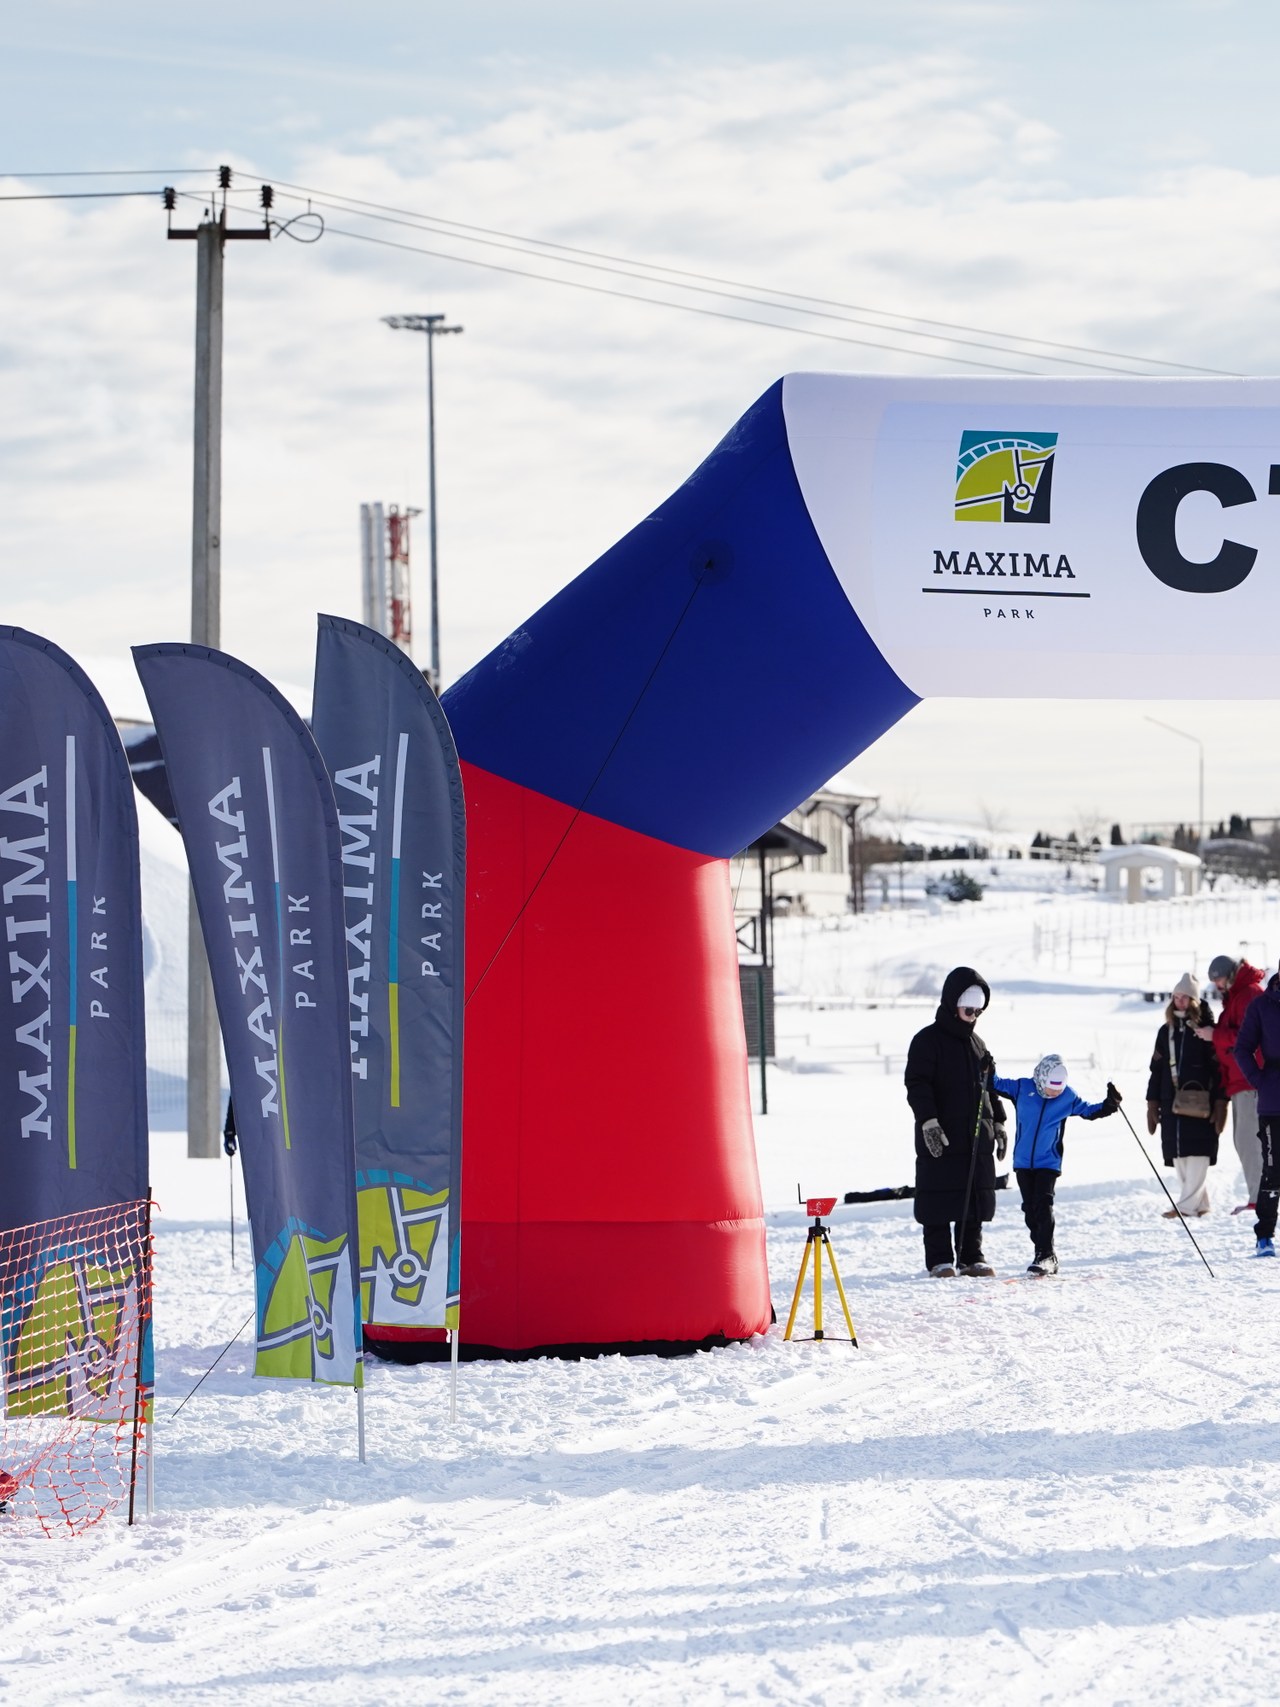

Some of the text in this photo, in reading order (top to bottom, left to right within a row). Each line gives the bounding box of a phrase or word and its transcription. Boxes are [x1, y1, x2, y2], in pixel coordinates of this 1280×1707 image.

[933, 550, 1076, 579] MAXIMA
[983, 608, 1036, 620] PARK
[0, 766, 51, 1140] MAXIMA
[90, 895, 109, 1018] PARK
[207, 776, 280, 1118] MAXIMA
[288, 894, 317, 1010] PARK
[421, 871, 442, 976] PARK
